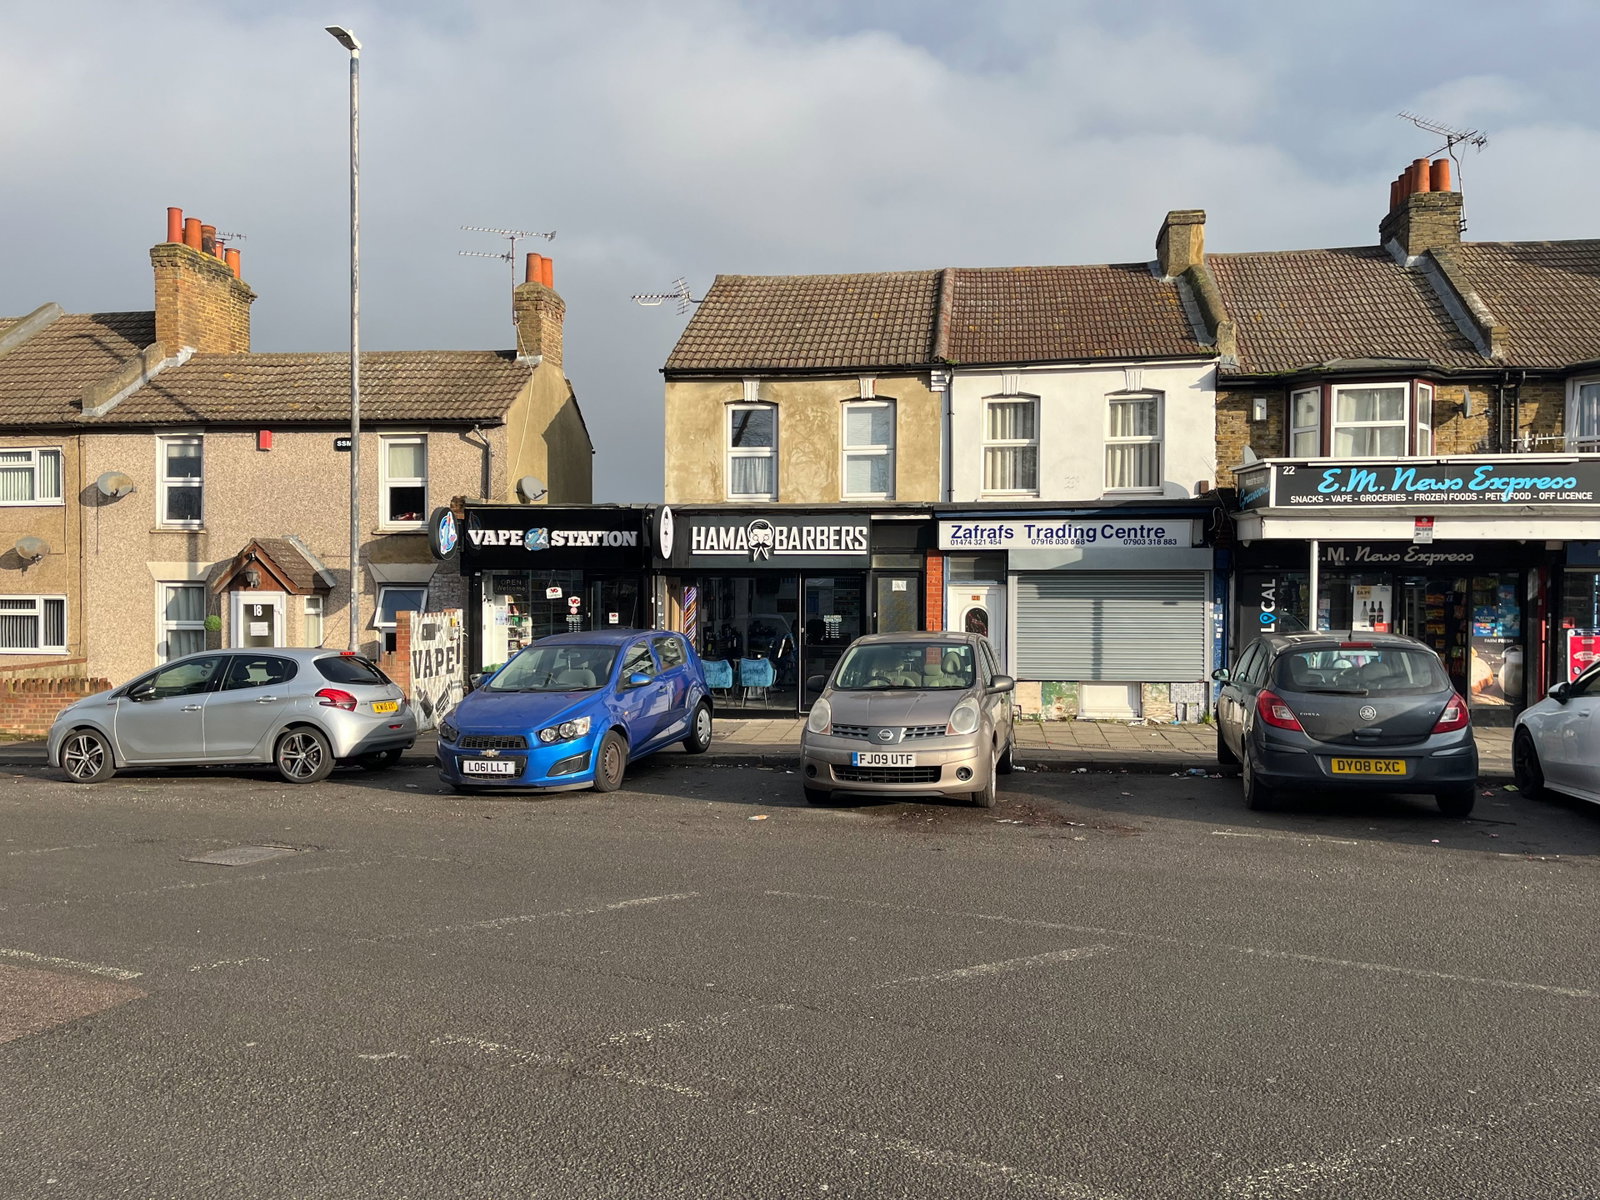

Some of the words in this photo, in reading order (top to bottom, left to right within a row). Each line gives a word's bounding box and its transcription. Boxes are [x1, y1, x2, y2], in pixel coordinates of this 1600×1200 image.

[1283, 466, 1295, 475] 22
[1317, 467, 1385, 493] E.M.
[1391, 467, 1463, 491] News
[1468, 465, 1577, 502] Express
[1290, 495, 1324, 504] SNACKS
[1331, 495, 1353, 503] VAPE
[1360, 494, 1407, 503] GROCERIES
[1414, 493, 1448, 502] FROZEN
[1449, 493, 1478, 502] FOODS
[1485, 492, 1506, 501] PETS
[1508, 492, 1532, 501] FOOD
[1539, 492, 1555, 500] OFF
[1557, 491, 1593, 500] LICENCE
[467, 529, 524, 546] VAPE
[551, 530, 637, 547] STATION
[692, 526, 749, 550] HAMA
[774, 526, 868, 550] BARBERS
[951, 524, 1014, 539] Zafrafs
[1024, 524, 1097, 542] Trading
[1101, 524, 1165, 539] Centre
[988, 538, 1002, 546] 454
[1031, 538, 1053, 546] 07916
[1055, 538, 1068, 546] 030
[1070, 538, 1086, 546] 868
[1123, 538, 1146, 546] 07903
[1147, 538, 1161, 546] 318
[1163, 538, 1177, 546] 883
[1355, 546, 1401, 561] News
[1404, 546, 1474, 566] Express
[253, 604, 262, 617] 18
[412, 646, 455, 679] VAPE
[859, 754, 888, 765] FJ09
[891, 754, 913, 765] UTF
[1337, 759, 1371, 772] DY08
[1374, 760, 1400, 772] GXC
[490, 762, 509, 773] LLT
